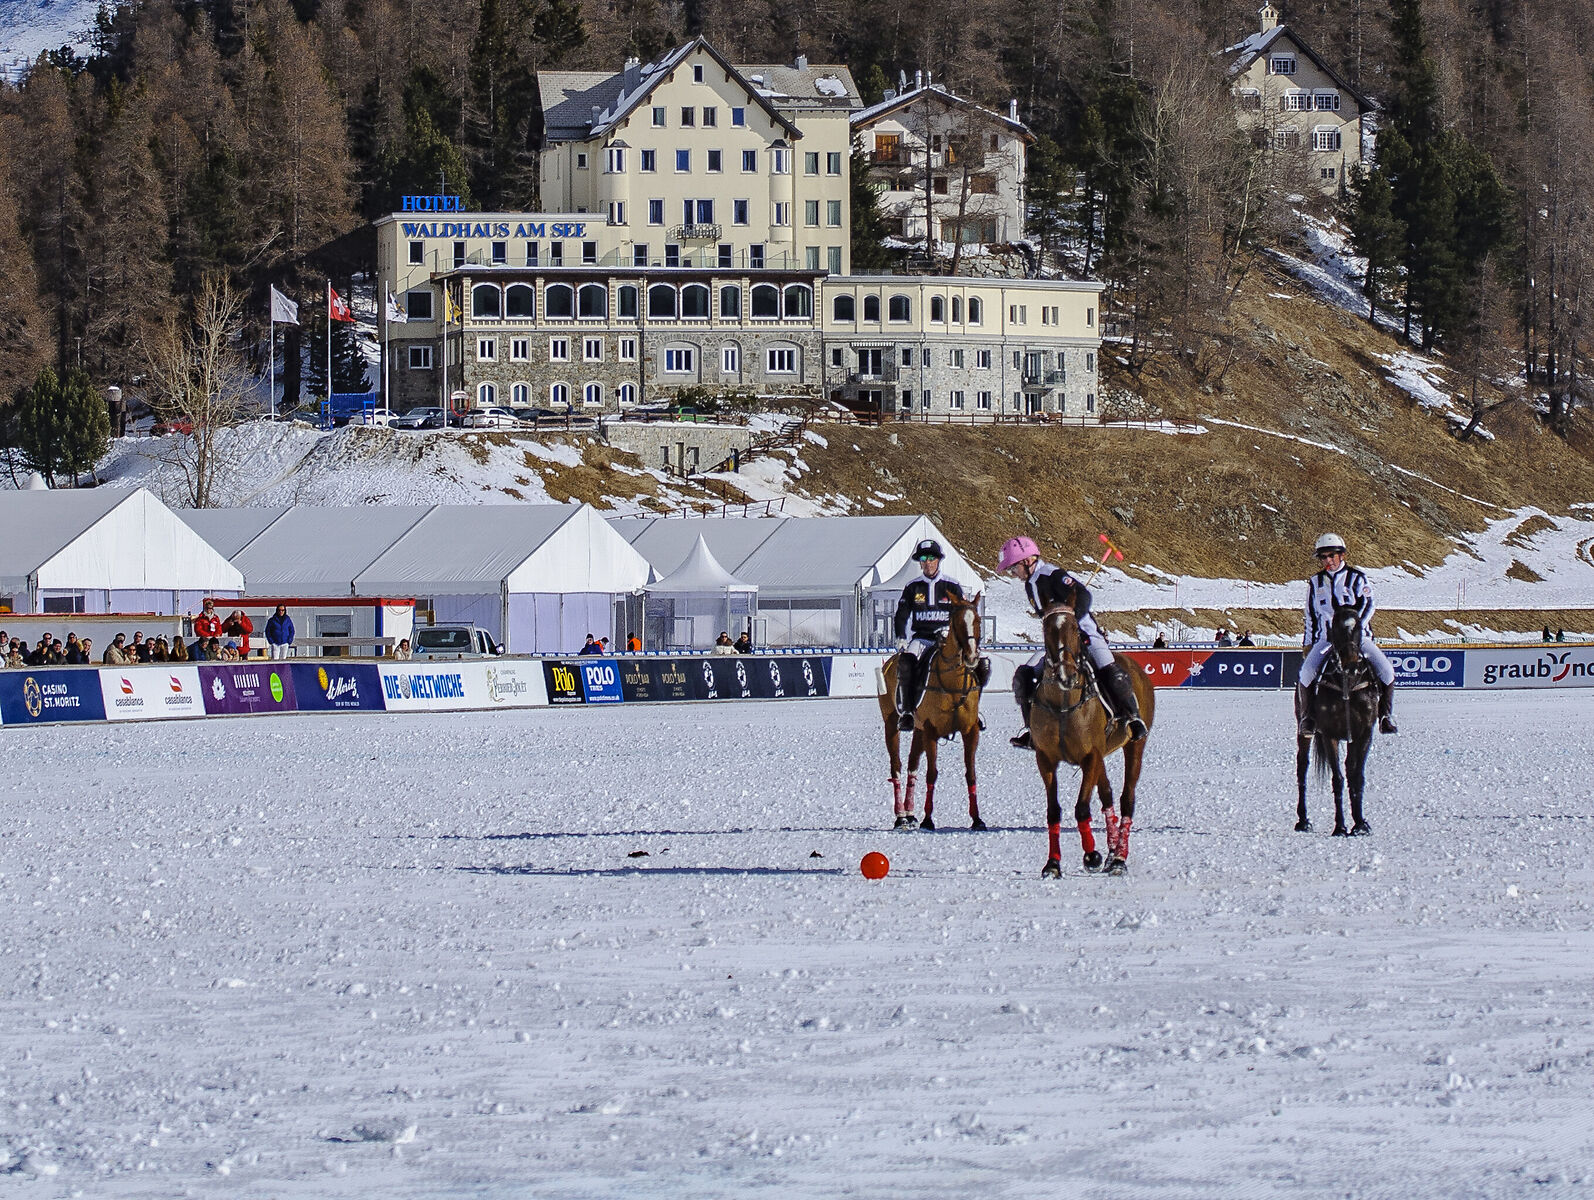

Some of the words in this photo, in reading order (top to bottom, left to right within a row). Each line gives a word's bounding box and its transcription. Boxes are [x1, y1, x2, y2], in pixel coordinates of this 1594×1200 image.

[401, 195, 466, 212] HOTEL
[401, 222, 510, 238] WALDHAUS
[513, 222, 546, 238] AM
[550, 222, 587, 238] SEE
[1144, 663, 1175, 675] OW
[1218, 663, 1275, 675] POLO
[1387, 656, 1452, 673] POLO
[586, 666, 615, 685] POLO
[42, 683, 68, 696] CASINO
[383, 675, 401, 699] DIE
[408, 674, 465, 699] WELTWOCHE
